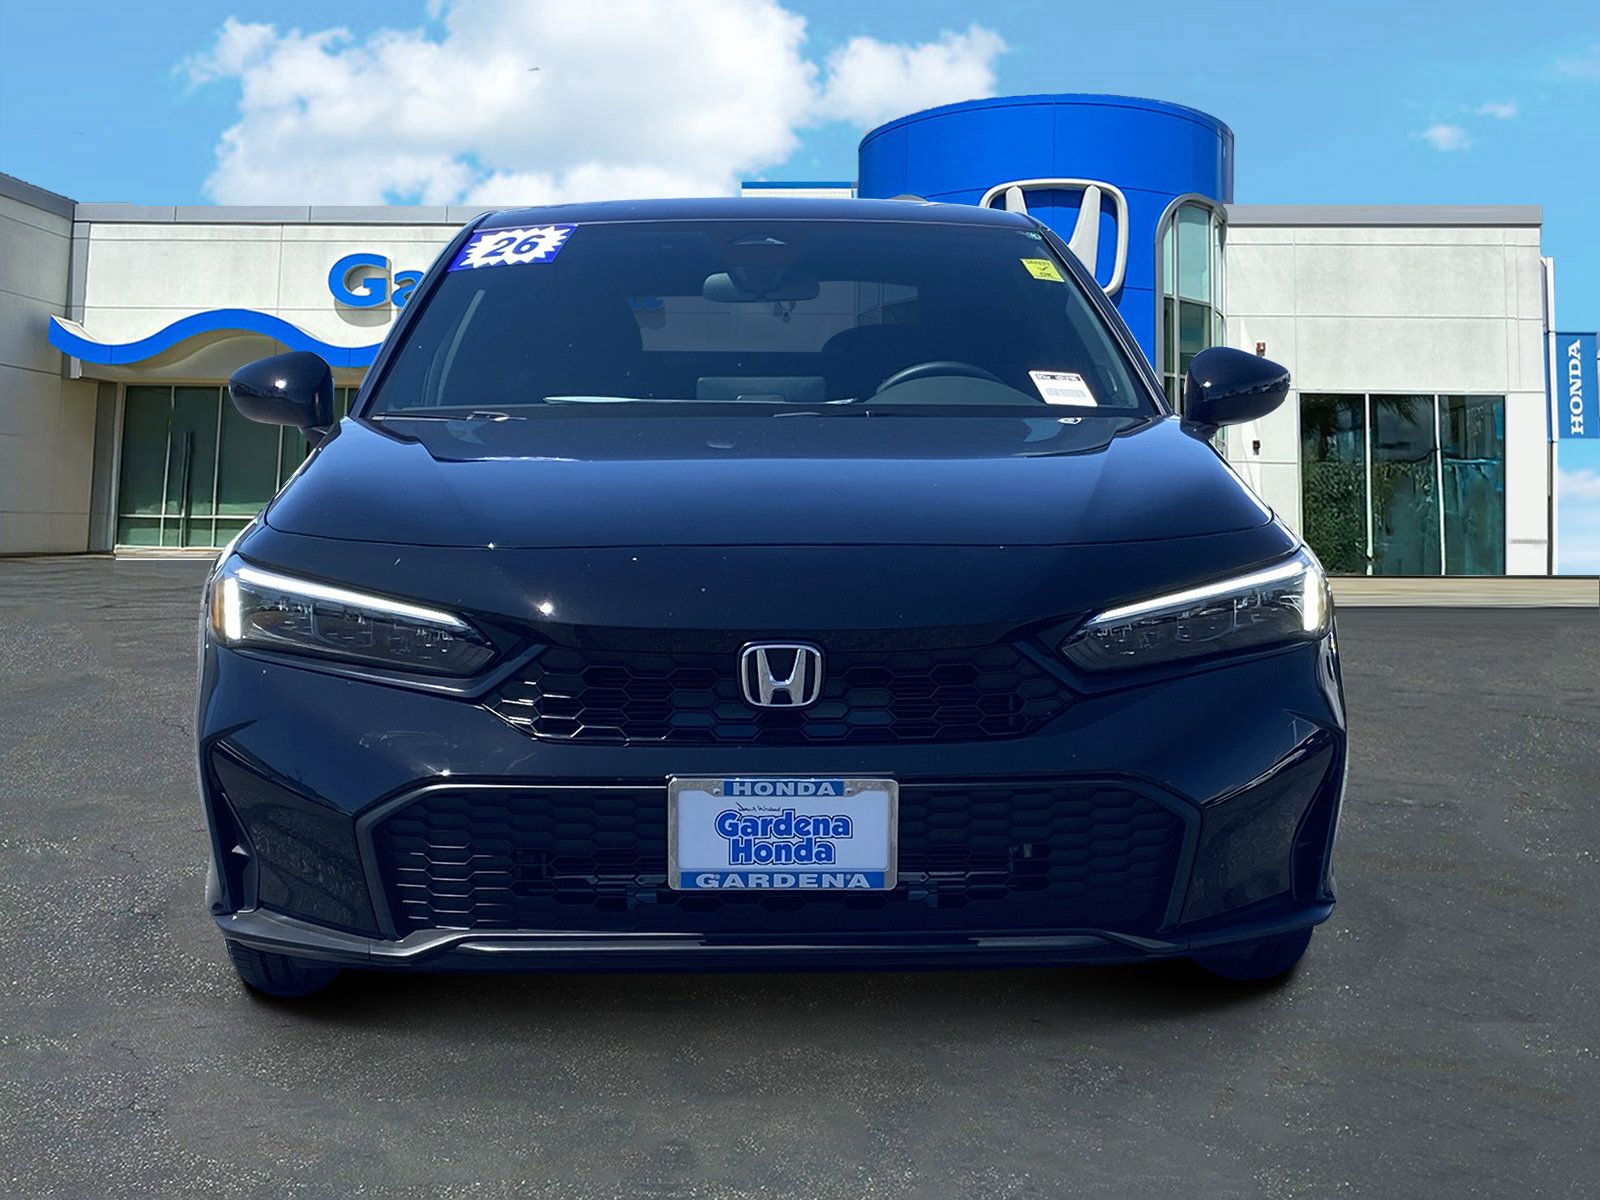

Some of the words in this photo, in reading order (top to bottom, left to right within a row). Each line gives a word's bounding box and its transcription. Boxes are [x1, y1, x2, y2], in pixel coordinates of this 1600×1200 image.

[480, 233, 546, 259] 26
[1567, 338, 1584, 435] HONDA
[732, 782, 836, 796] HONDA
[715, 808, 853, 839] Gardena
[729, 837, 836, 865] Honda
[695, 873, 871, 889] GARDENA
